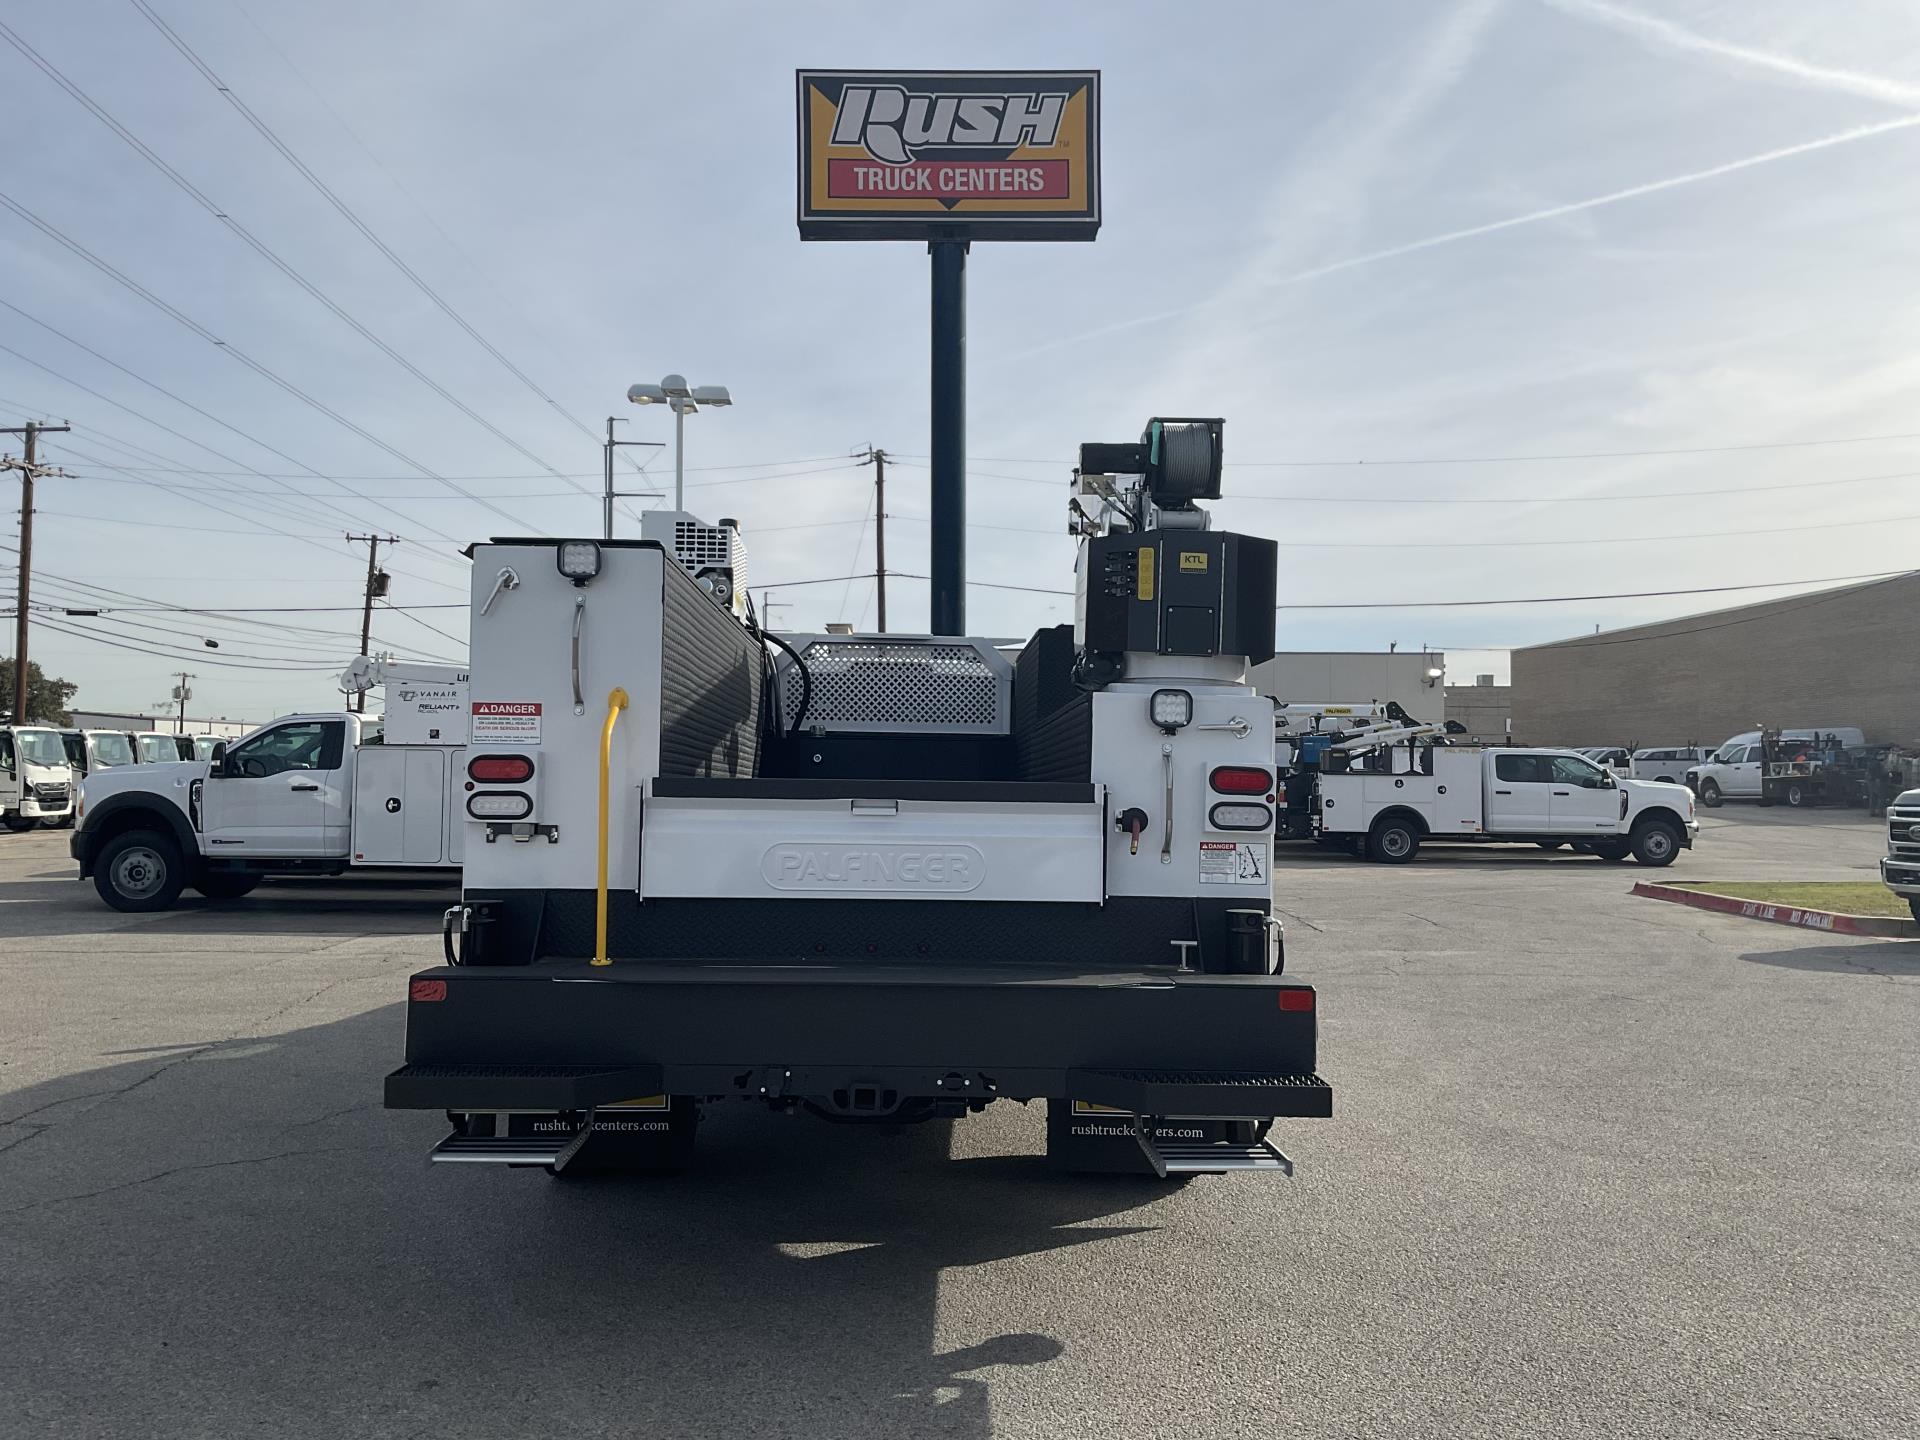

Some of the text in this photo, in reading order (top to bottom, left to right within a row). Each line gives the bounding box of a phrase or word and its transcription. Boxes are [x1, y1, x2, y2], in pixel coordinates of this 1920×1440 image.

[828, 84, 1069, 166] RUSH
[853, 167, 1044, 192] TRUCK CENTERS
[1184, 555, 1205, 564] KTL
[418, 703, 456, 711] RELIANT
[490, 704, 536, 714] DANGER
[775, 851, 969, 883] PALFINGER
